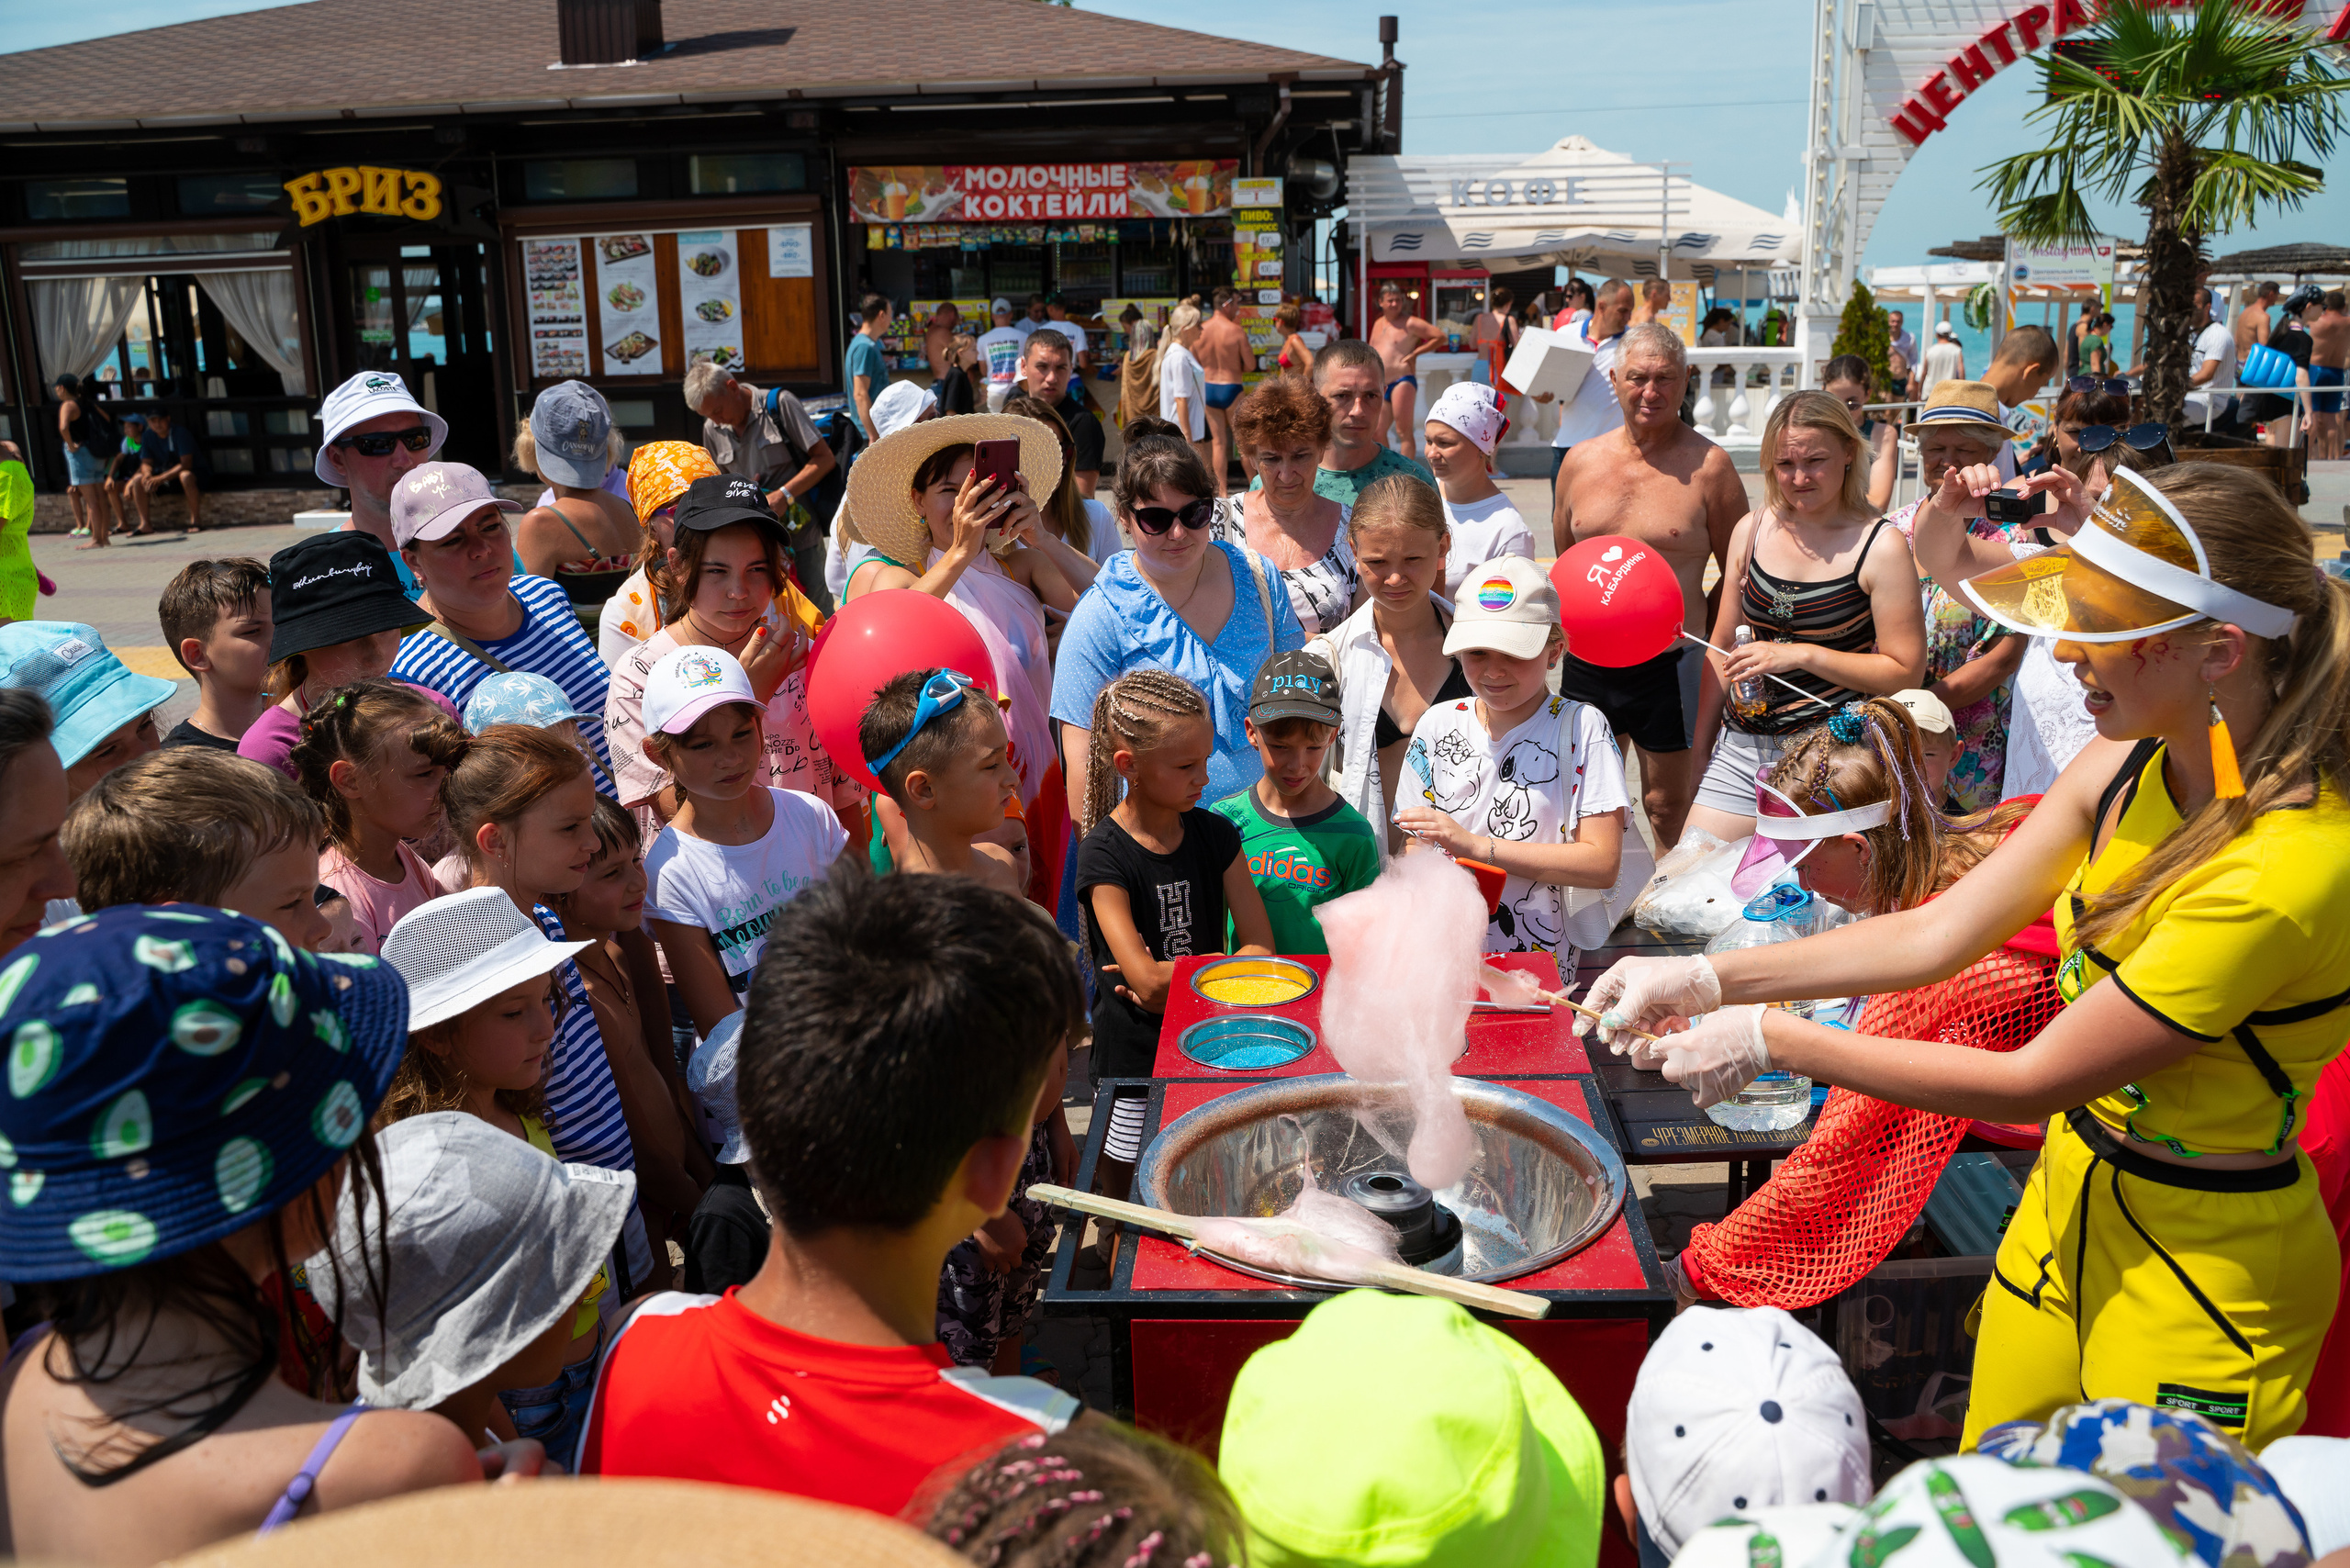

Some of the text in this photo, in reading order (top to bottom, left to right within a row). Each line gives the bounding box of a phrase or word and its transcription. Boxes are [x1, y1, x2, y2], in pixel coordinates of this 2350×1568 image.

[964, 163, 1127, 191] МОЛОЧНЫЕ
[284, 164, 442, 228] БРИЗ
[964, 190, 1128, 219] КОКТЕЙЛИ
[1451, 176, 1585, 208] КОФЕ
[1240, 210, 1274, 222] ПИВО:
[367, 386, 397, 394] LACOSTE
[408, 468, 444, 494] BABY
[1586, 564, 1612, 588] Я
[1600, 551, 1647, 606] КАБАРДИНКУ
[1270, 674, 1323, 694] play
[1218, 801, 1252, 827] adidas
[1246, 850, 1331, 889] didas
[716, 892, 764, 931] Born
[761, 879, 782, 898] to
[781, 870, 800, 892] be
[2058, 958, 2075, 982] SPORT
[1652, 1126, 1733, 1146] ЧРЕЗМЕРНОЕ
[2165, 1396, 2241, 1415] SPORT SPORT
